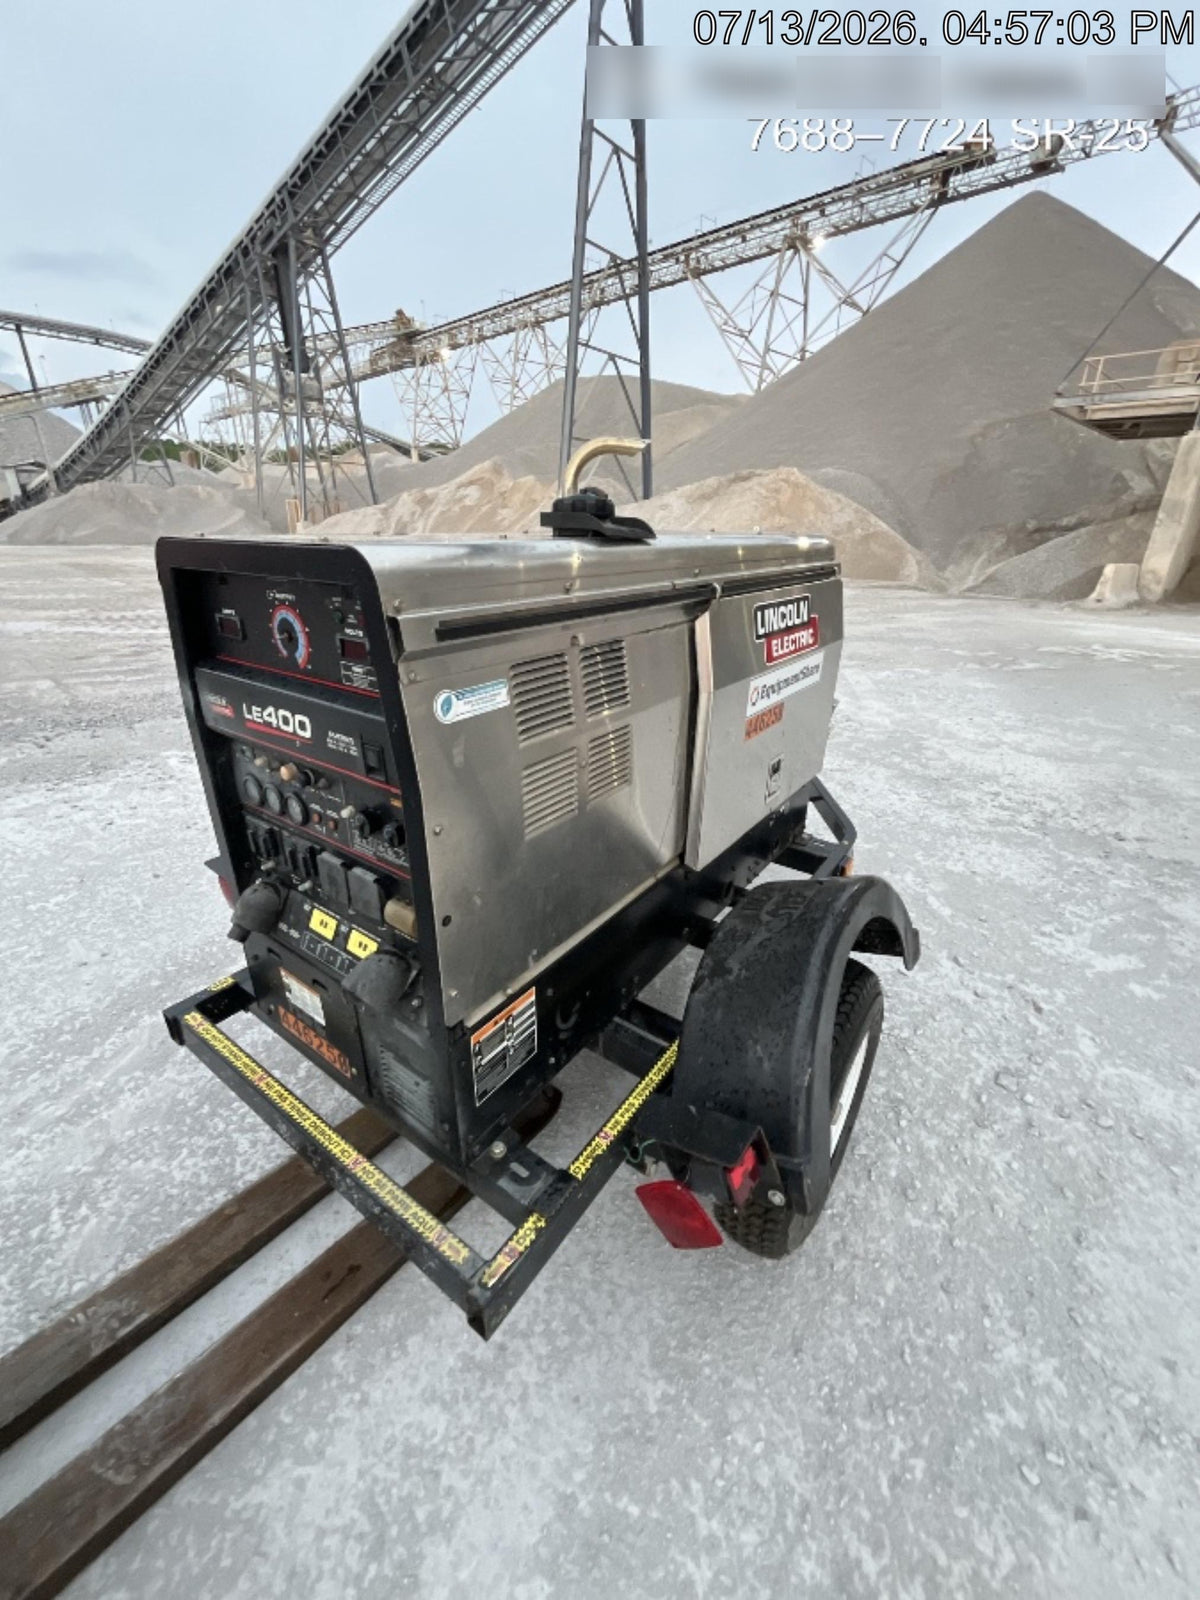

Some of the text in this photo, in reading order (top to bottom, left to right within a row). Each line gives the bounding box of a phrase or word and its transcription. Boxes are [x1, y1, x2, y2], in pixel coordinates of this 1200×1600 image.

[757, 600, 808, 635] LINCOLN
[772, 628, 814, 658] ELECTRIC
[242, 703, 311, 738] LE400
[307, 1118, 340, 1149] DEBOUT
[338, 1146, 353, 1160] ICI
[359, 1165, 376, 1181] NO
